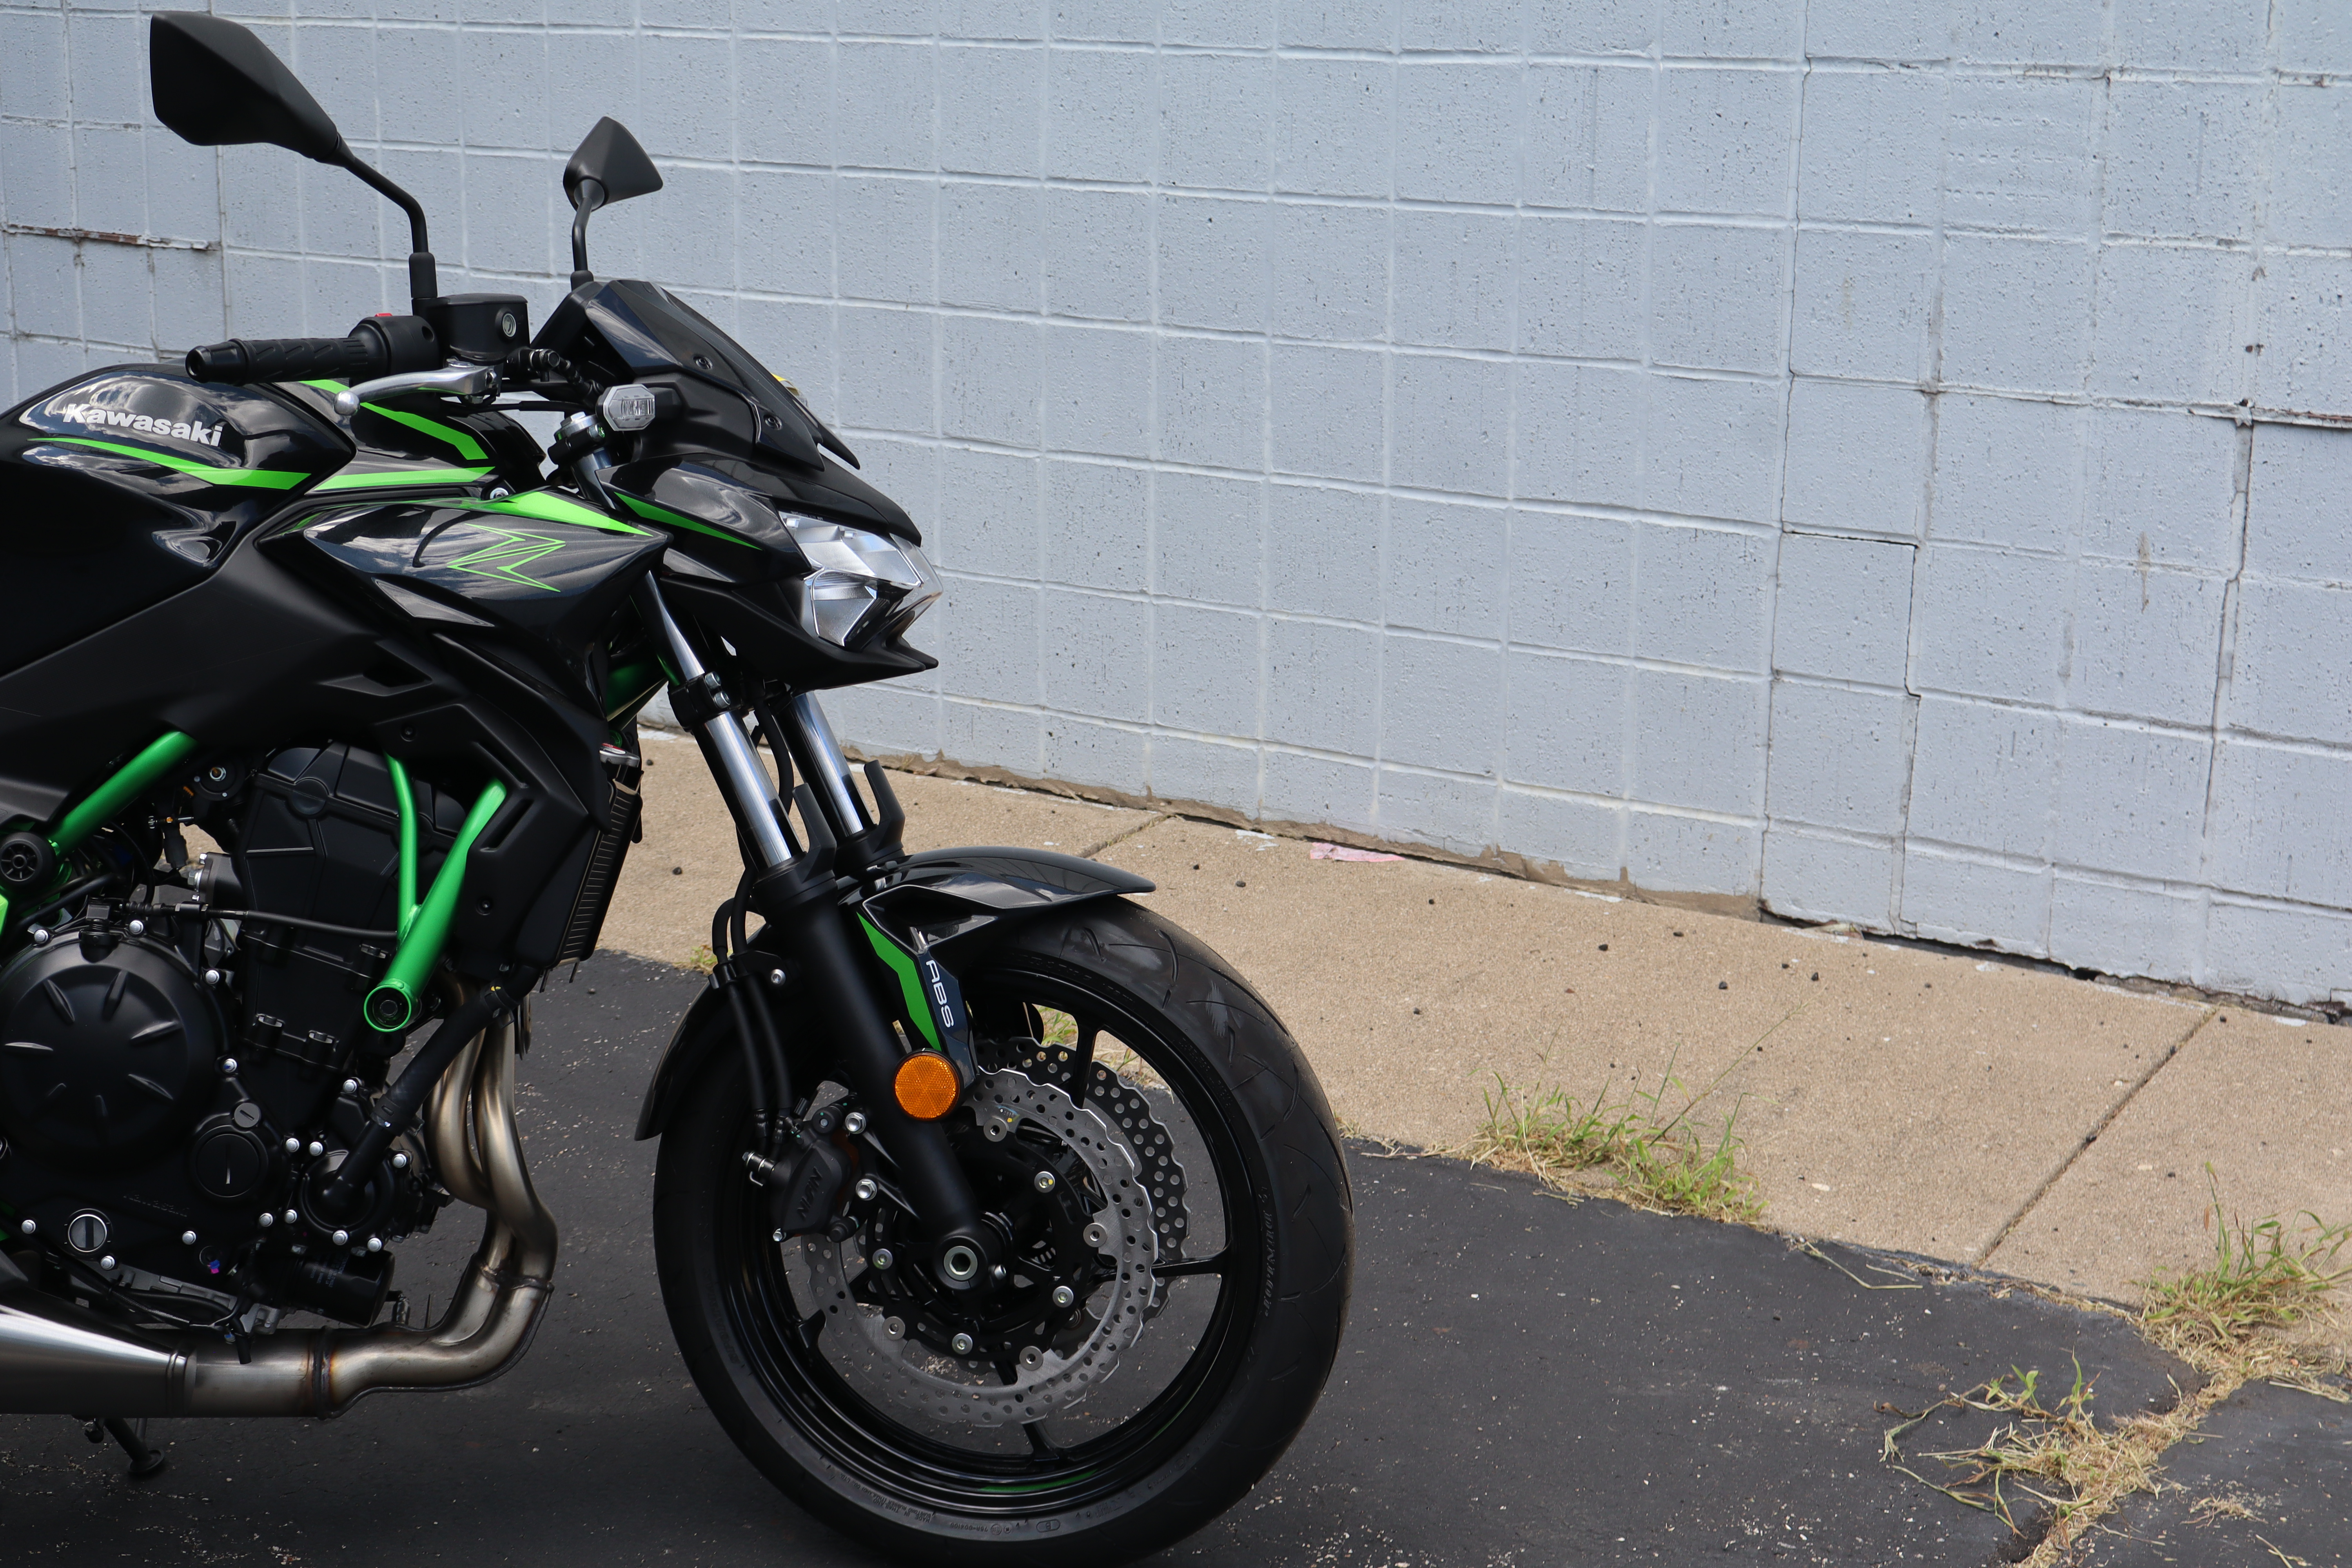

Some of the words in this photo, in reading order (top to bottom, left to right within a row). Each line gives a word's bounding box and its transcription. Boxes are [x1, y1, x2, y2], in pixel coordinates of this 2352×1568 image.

[63, 403, 222, 447] Kawasaki
[926, 960, 953, 1027] ABS
[1259, 1209, 1276, 1318] DUNLOP
